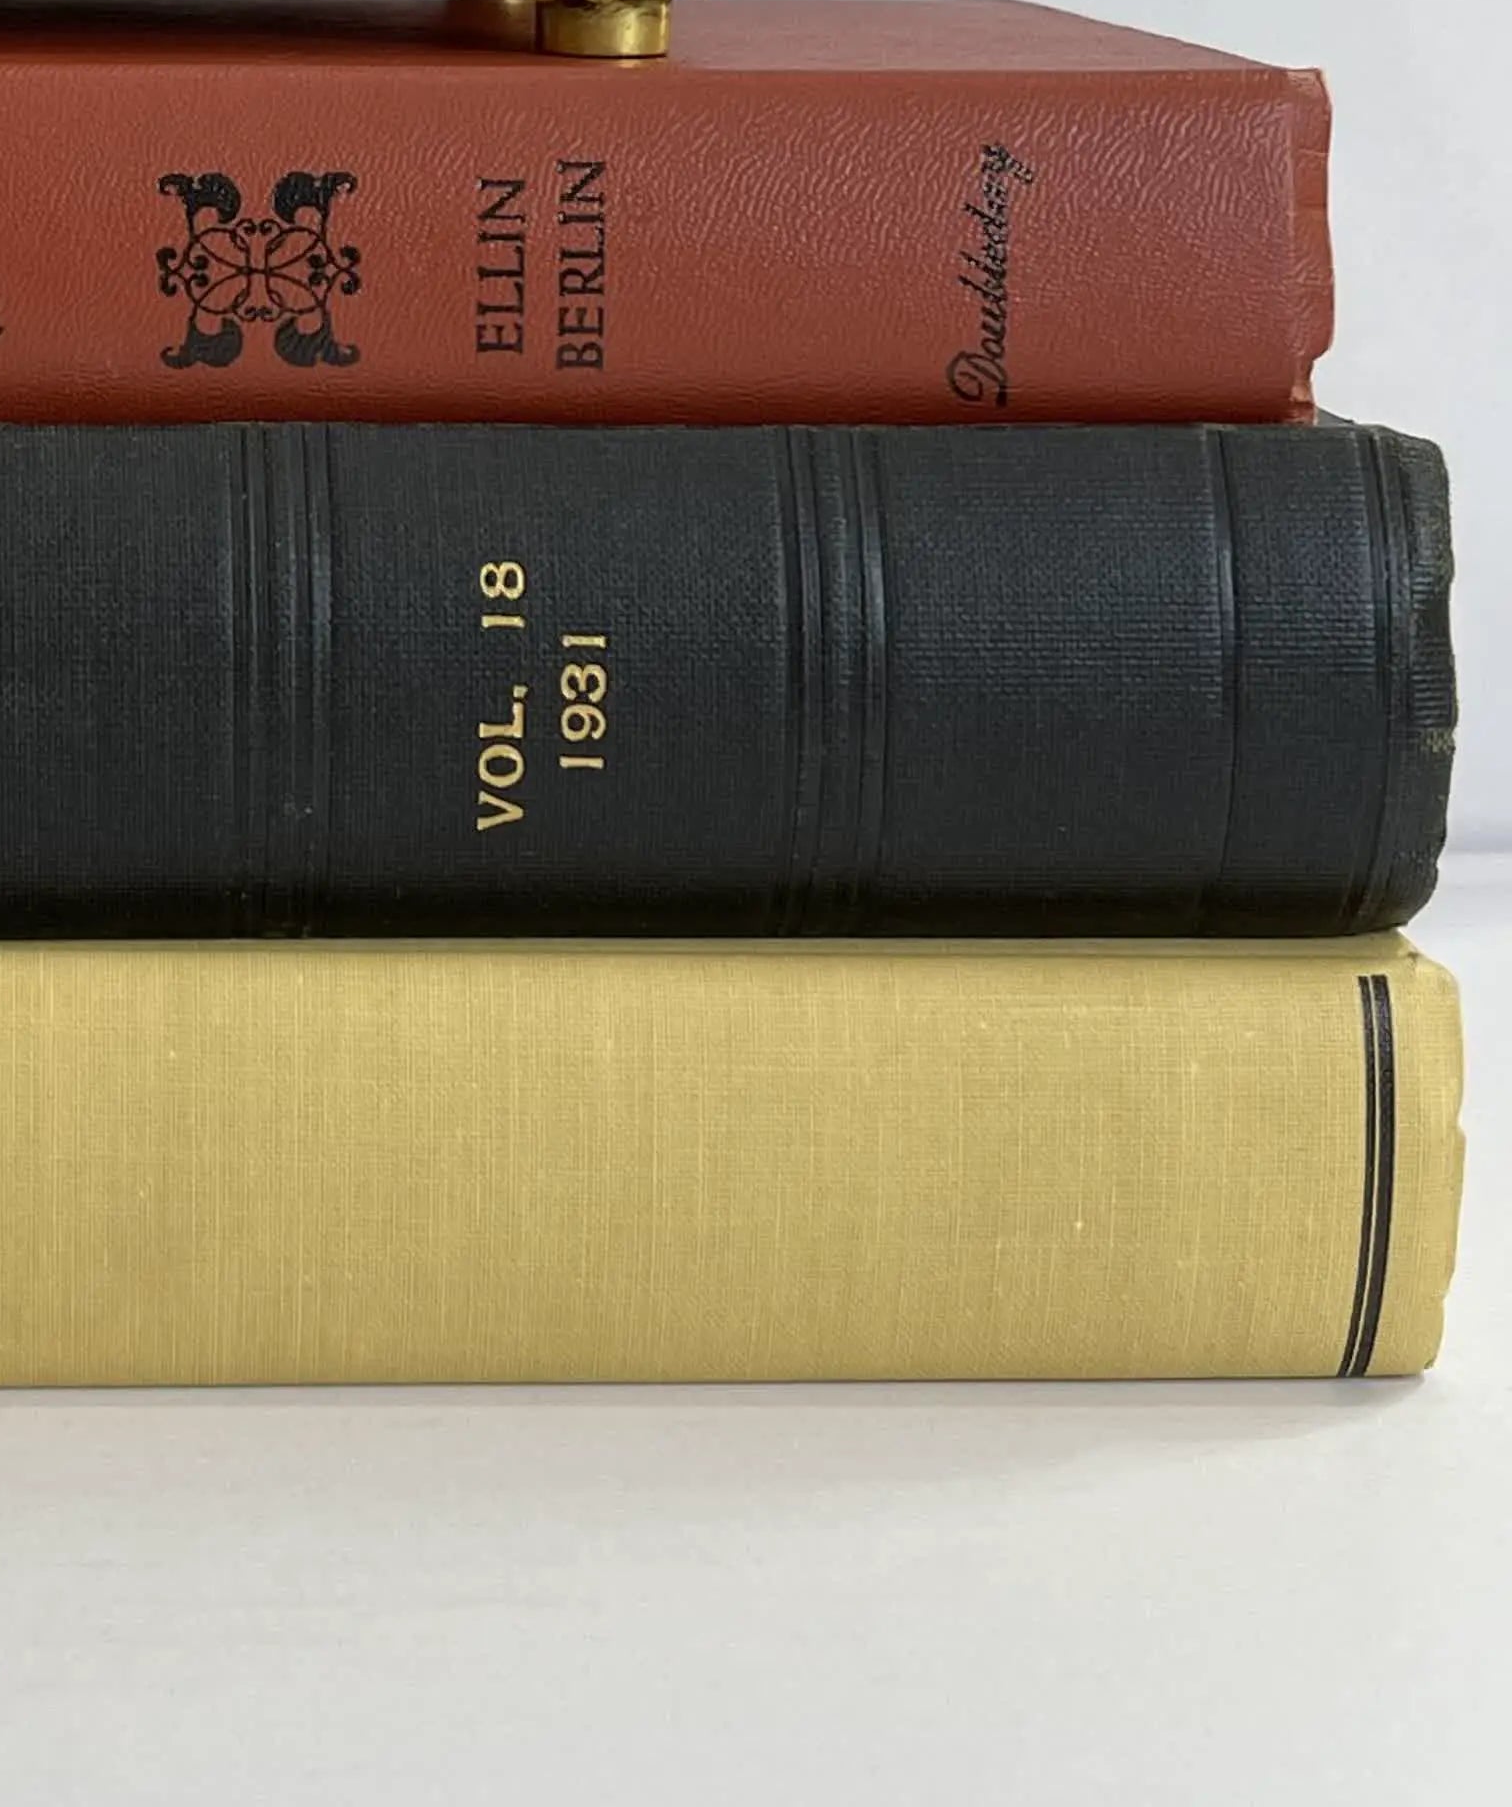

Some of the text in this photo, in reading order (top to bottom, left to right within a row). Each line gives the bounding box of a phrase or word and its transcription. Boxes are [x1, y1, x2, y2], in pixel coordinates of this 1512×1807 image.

[475, 177, 526, 354] ELLIN
[555, 159, 606, 370] BERLIN
[477, 561, 528, 830] VOL. 18
[559, 635, 607, 769] 1931
